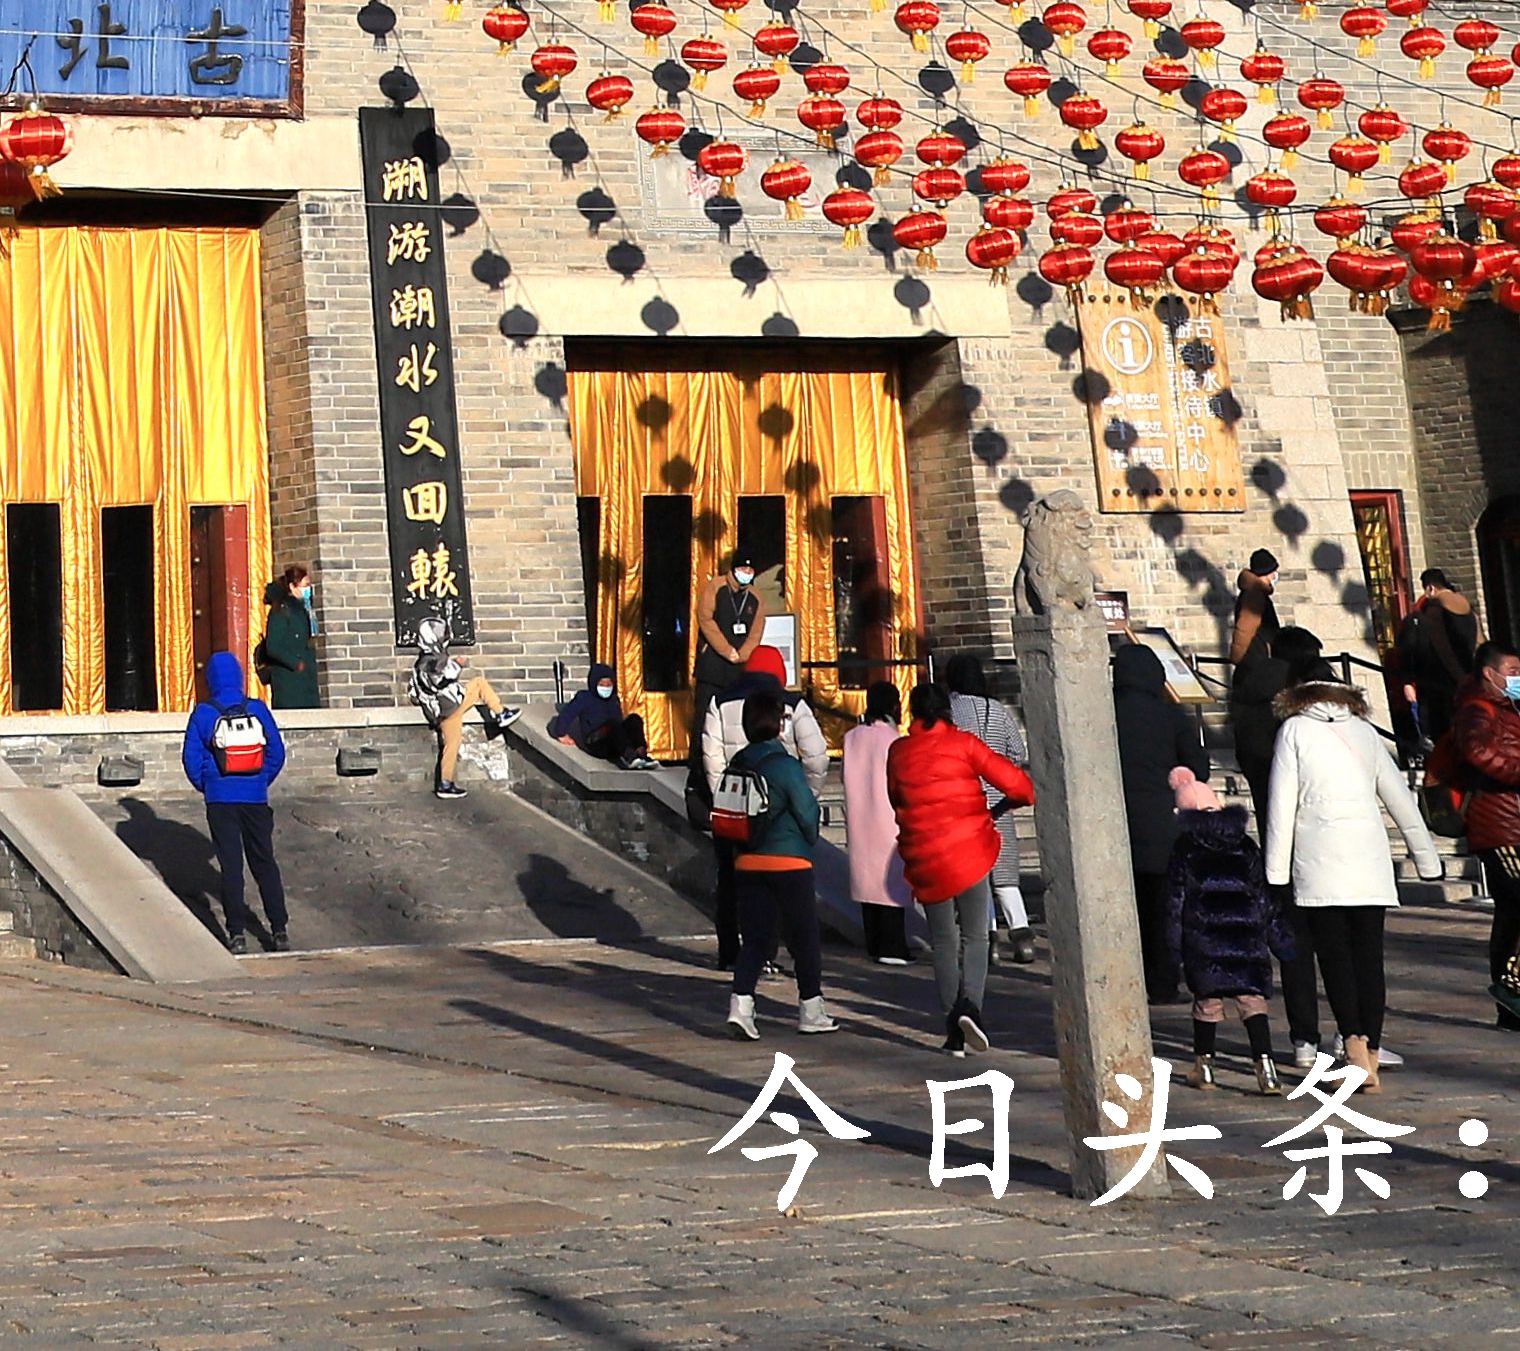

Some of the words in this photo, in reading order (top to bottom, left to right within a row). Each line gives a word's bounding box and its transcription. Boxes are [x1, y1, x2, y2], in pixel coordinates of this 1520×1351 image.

[1173, 316, 1211, 473] 游客接待中心
[1192, 315, 1223, 419] 古北水镇
